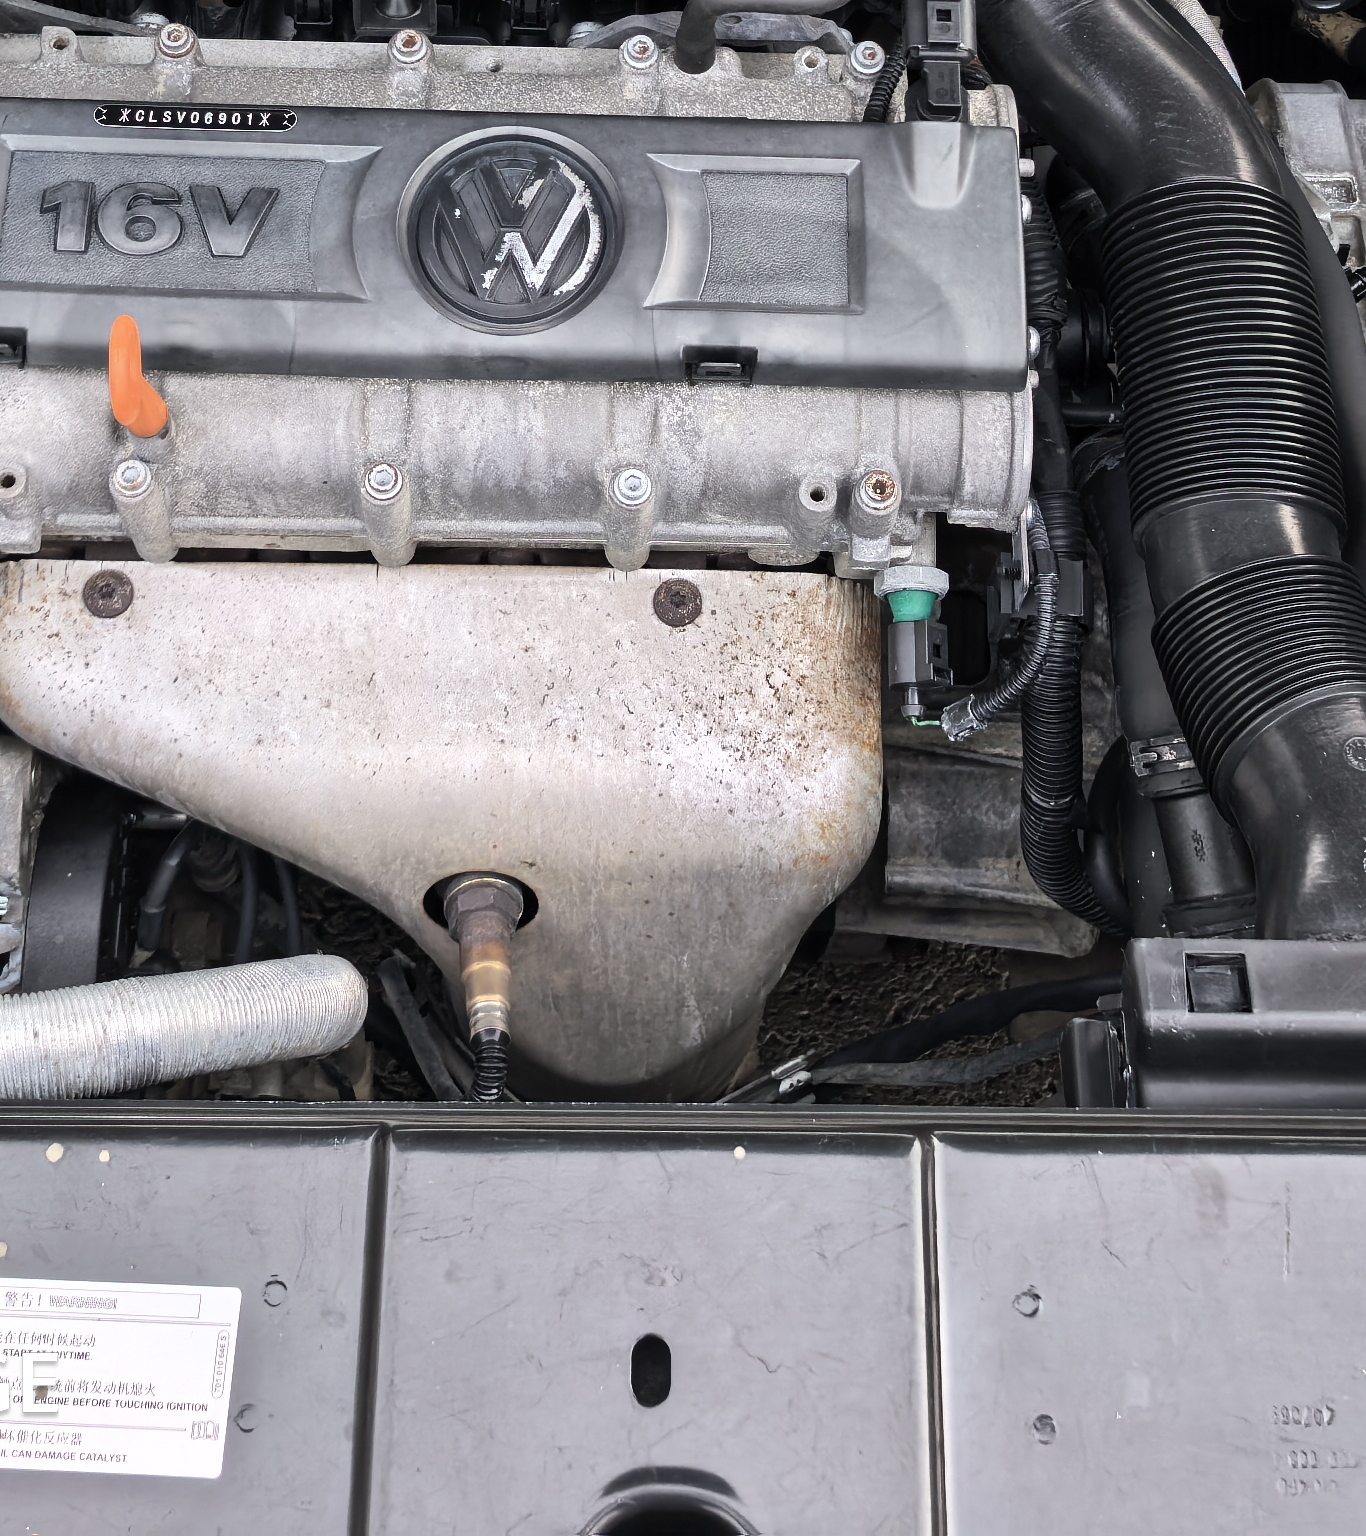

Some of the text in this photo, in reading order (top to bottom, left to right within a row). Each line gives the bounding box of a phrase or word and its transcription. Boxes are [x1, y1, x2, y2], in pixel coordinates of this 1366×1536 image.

[39, 179, 281, 258] 16V
[49, 1295, 118, 1310] WARNING!
[73, 1398, 111, 1408] BEFORE
[115, 1399, 164, 1410] TOUCHING
[166, 1401, 208, 1412] IGNITION
[11, 1449, 32, 1459] CAN
[34, 1450, 77, 1461] DAMAGE
[79, 1451, 128, 1463] CATALYST.
